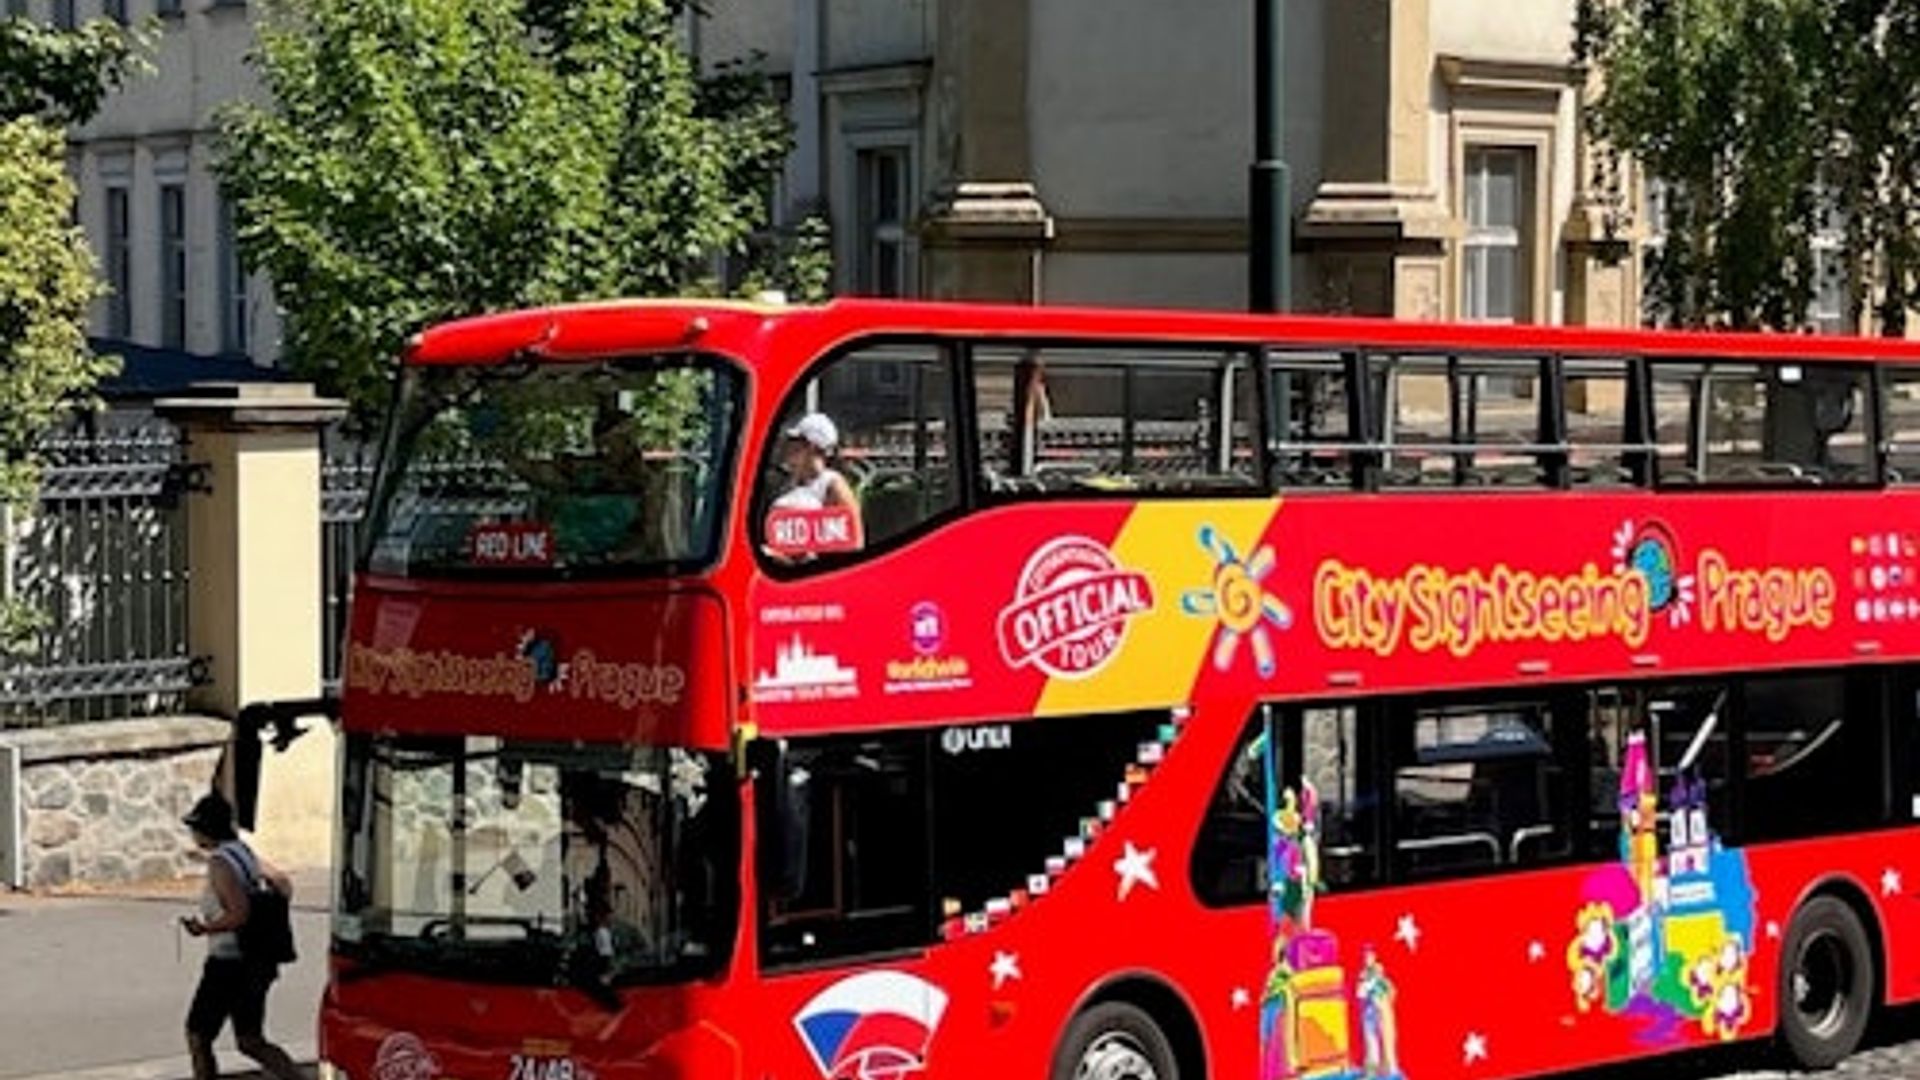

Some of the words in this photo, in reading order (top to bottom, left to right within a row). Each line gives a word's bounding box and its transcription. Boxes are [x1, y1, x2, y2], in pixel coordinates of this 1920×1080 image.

[476, 532, 508, 560] RED
[514, 532, 547, 560] LINE
[772, 517, 808, 546] RED
[814, 515, 850, 542] LINE
[1015, 577, 1146, 649] OFFICIAL
[1314, 559, 1402, 656] City
[1404, 562, 1649, 656] Sightseeing
[1697, 548, 1836, 642] Prague
[1059, 627, 1117, 668] TOUR
[568, 650, 686, 709] Prague
